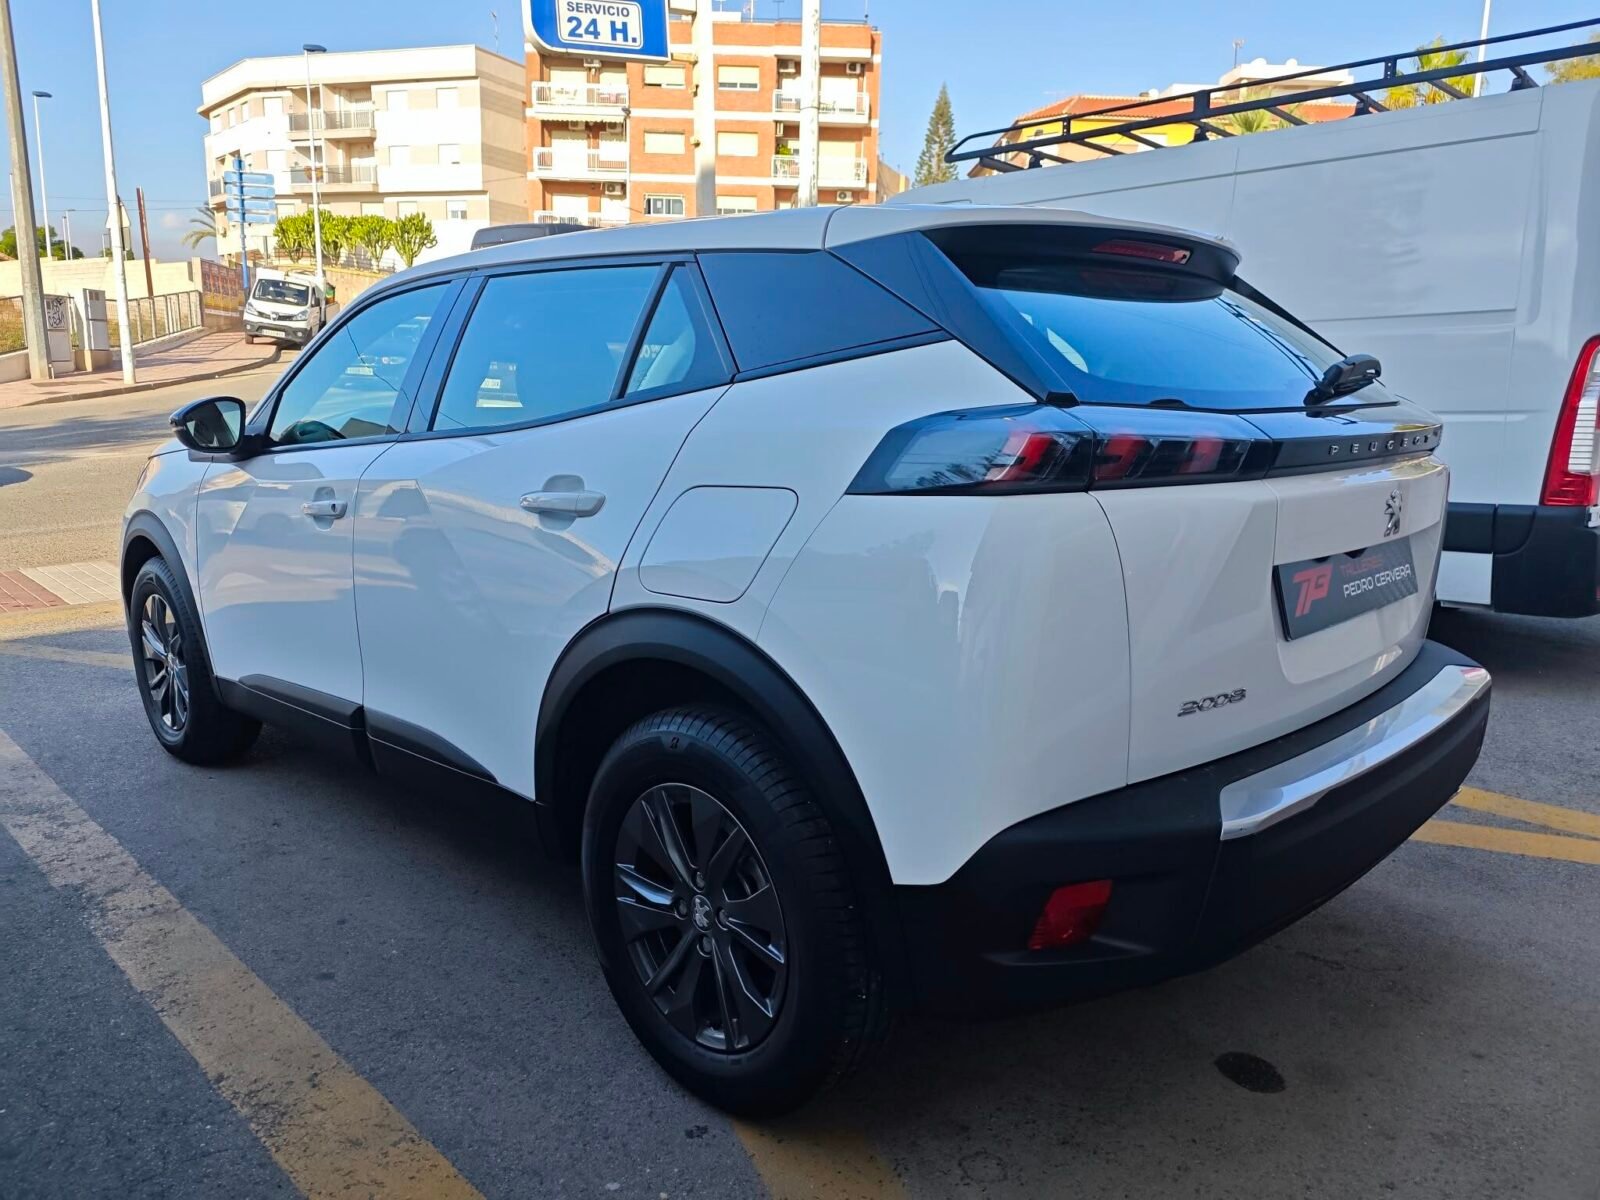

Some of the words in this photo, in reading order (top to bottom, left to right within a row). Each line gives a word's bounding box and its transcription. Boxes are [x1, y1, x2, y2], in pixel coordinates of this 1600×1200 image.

[567, 2, 630, 17] SERVICIO
[567, 16, 600, 39] 24
[610, 21, 637, 43] H.
[1329, 434, 1430, 455] PEUGEOT
[1343, 576, 1374, 598] PEDRO
[1375, 564, 1411, 587] CERVERA
[1177, 688, 1246, 717] 2008
